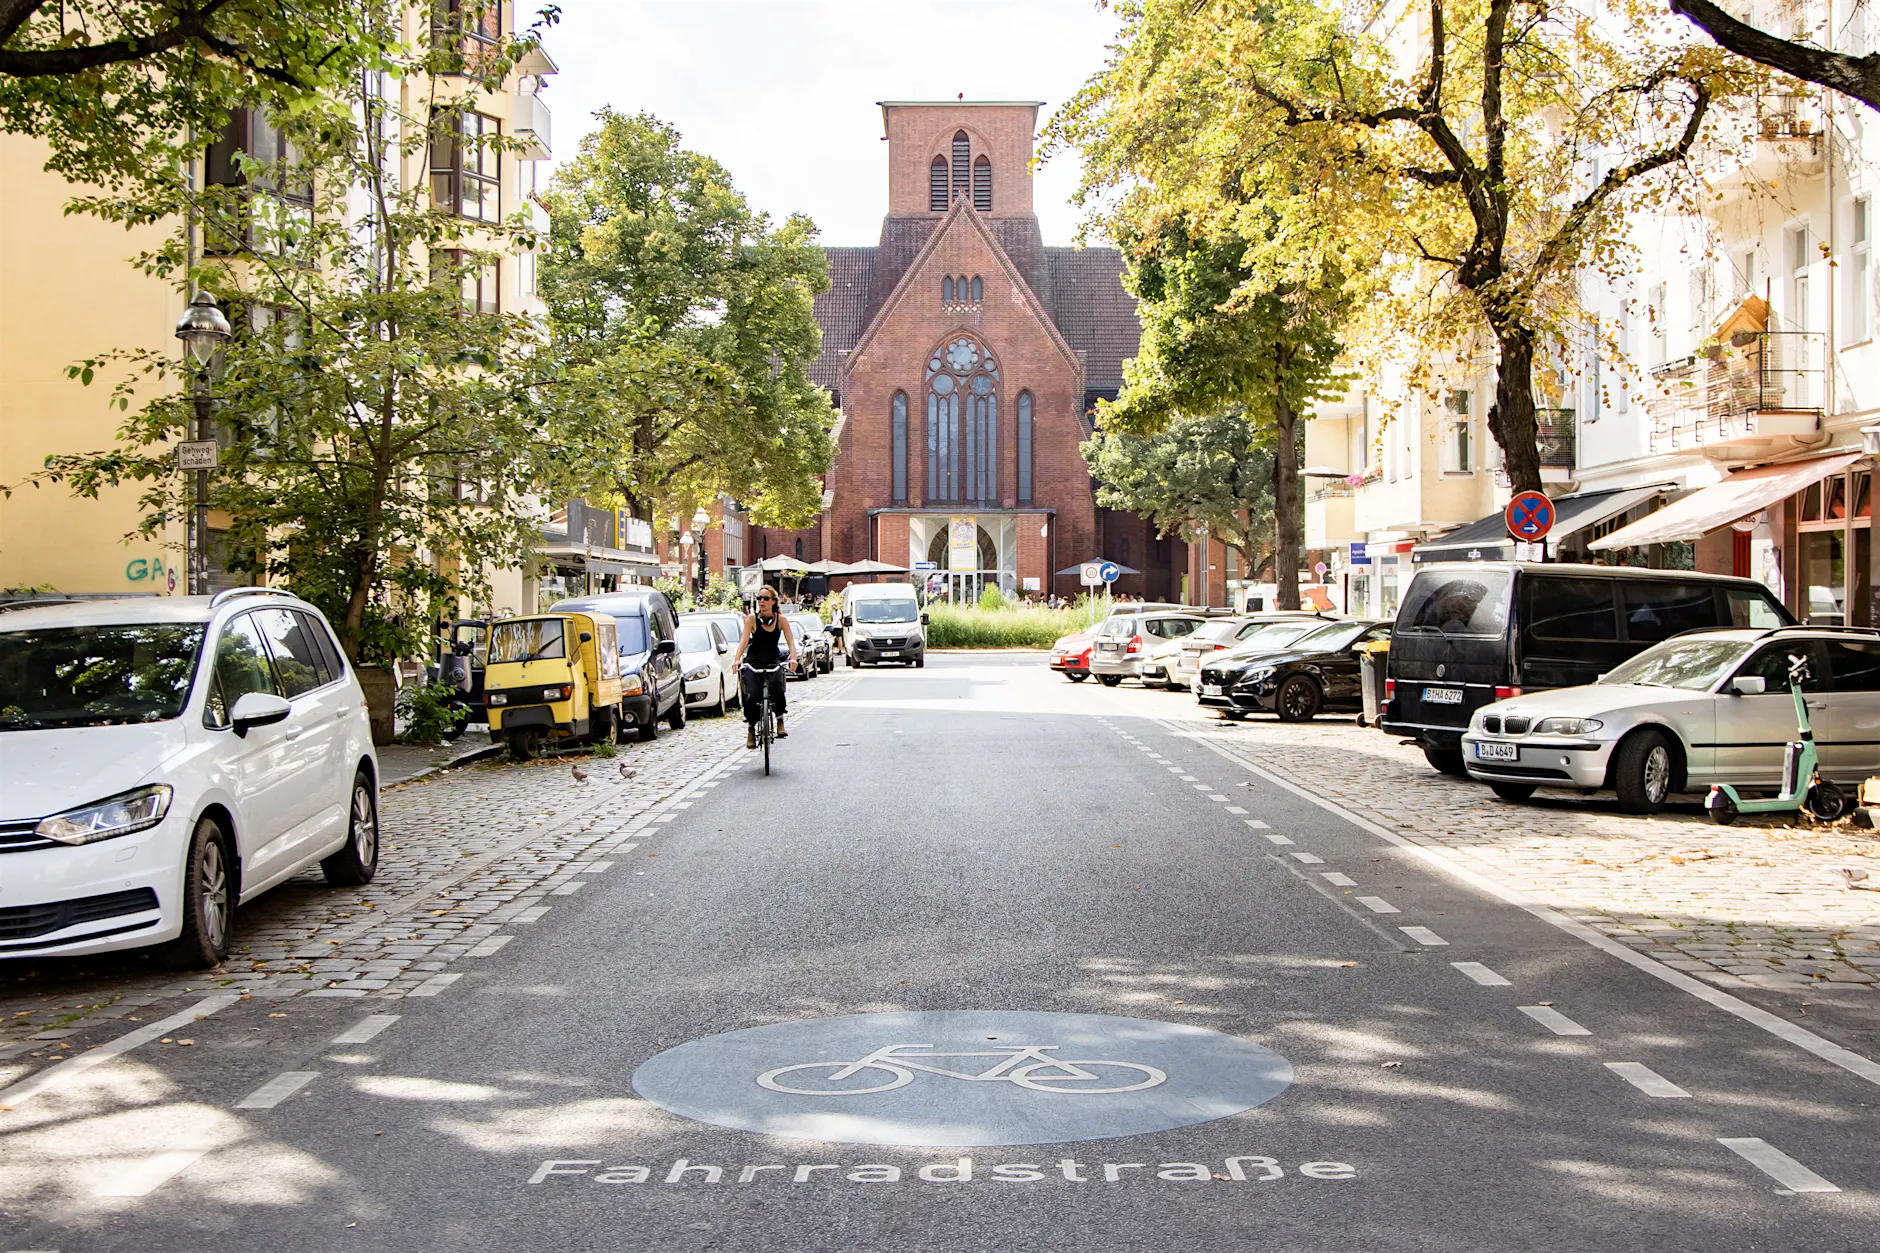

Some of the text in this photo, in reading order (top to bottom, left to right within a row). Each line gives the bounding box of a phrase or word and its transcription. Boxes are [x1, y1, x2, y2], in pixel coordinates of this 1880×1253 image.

[182, 445, 212, 455] Gehweg-
[126, 557, 165, 581] GA
[1427, 689, 1462, 701] B HA 6272
[1481, 744, 1514, 757] B D 4649
[526, 1155, 1356, 1185] Fahrradstraße
